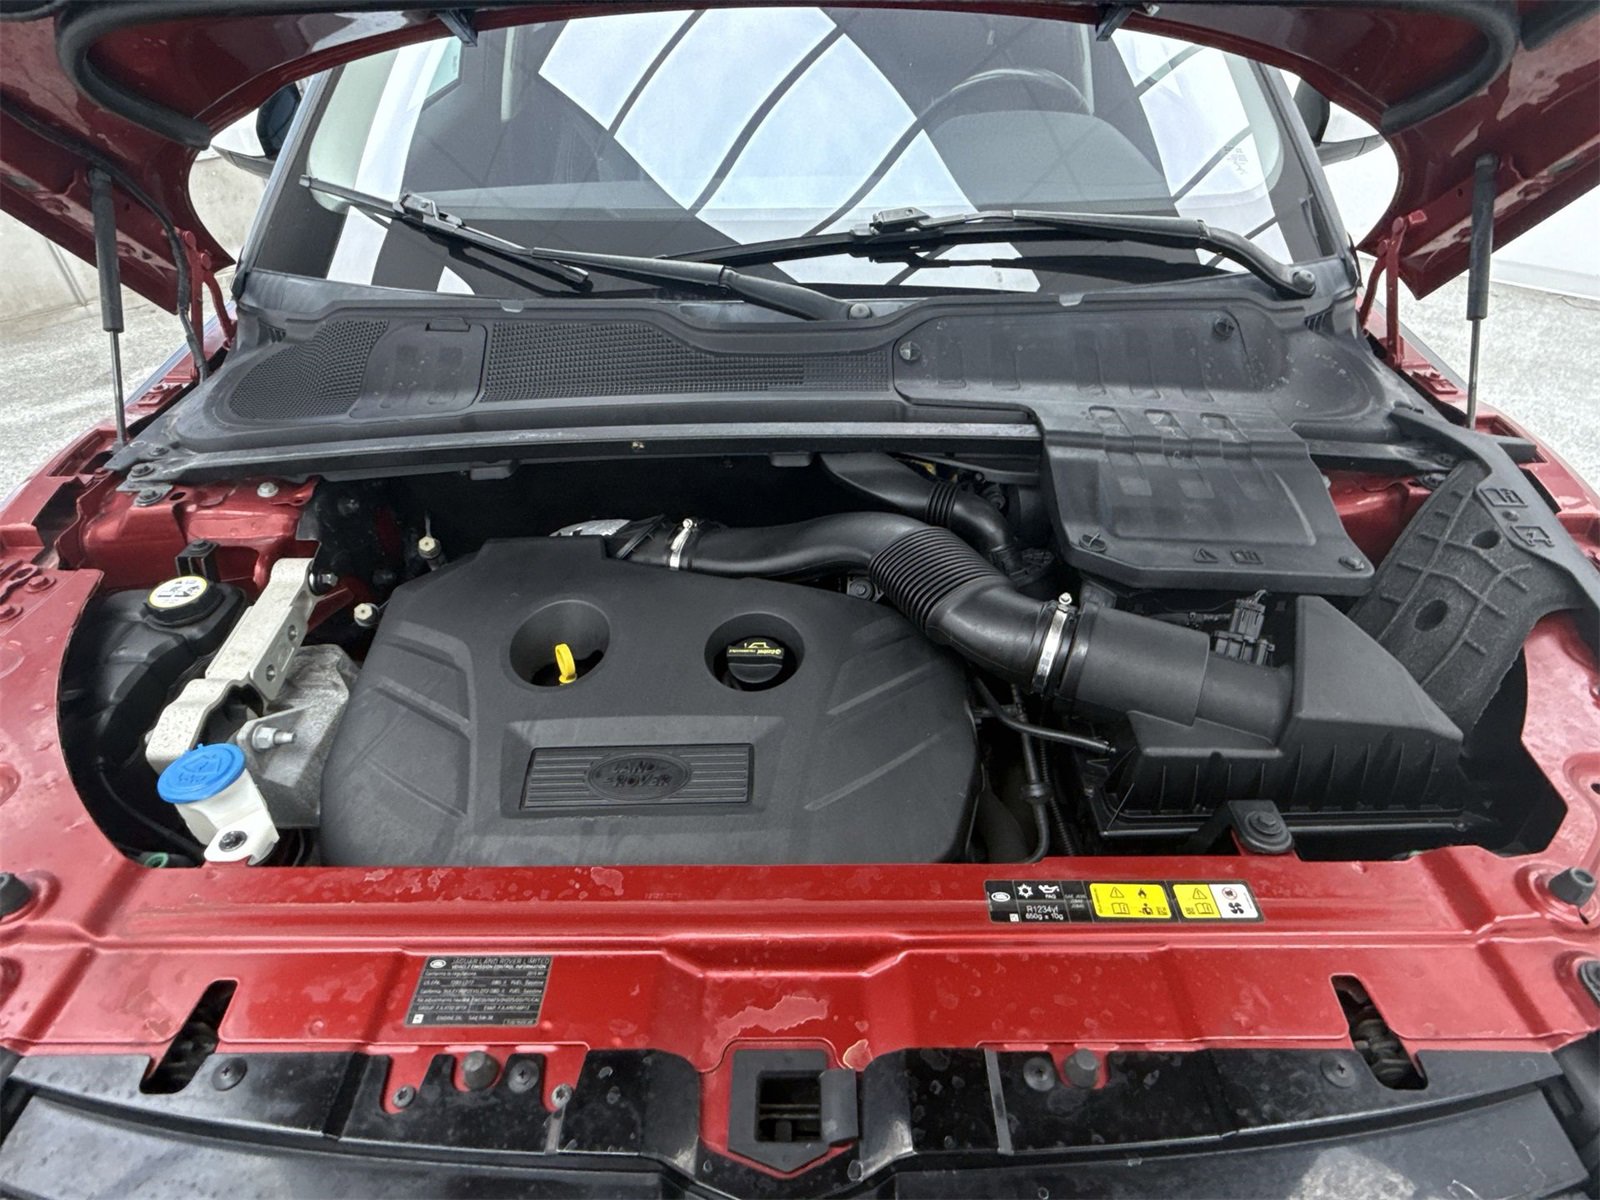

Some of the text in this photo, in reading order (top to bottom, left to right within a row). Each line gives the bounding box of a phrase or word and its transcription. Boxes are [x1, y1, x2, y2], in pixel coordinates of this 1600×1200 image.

[613, 774, 674, 788] ROVER
[1026, 905, 1059, 913] R1234yf
[499, 957, 522, 965] ROVER
[522, 957, 550, 965] LIMITED
